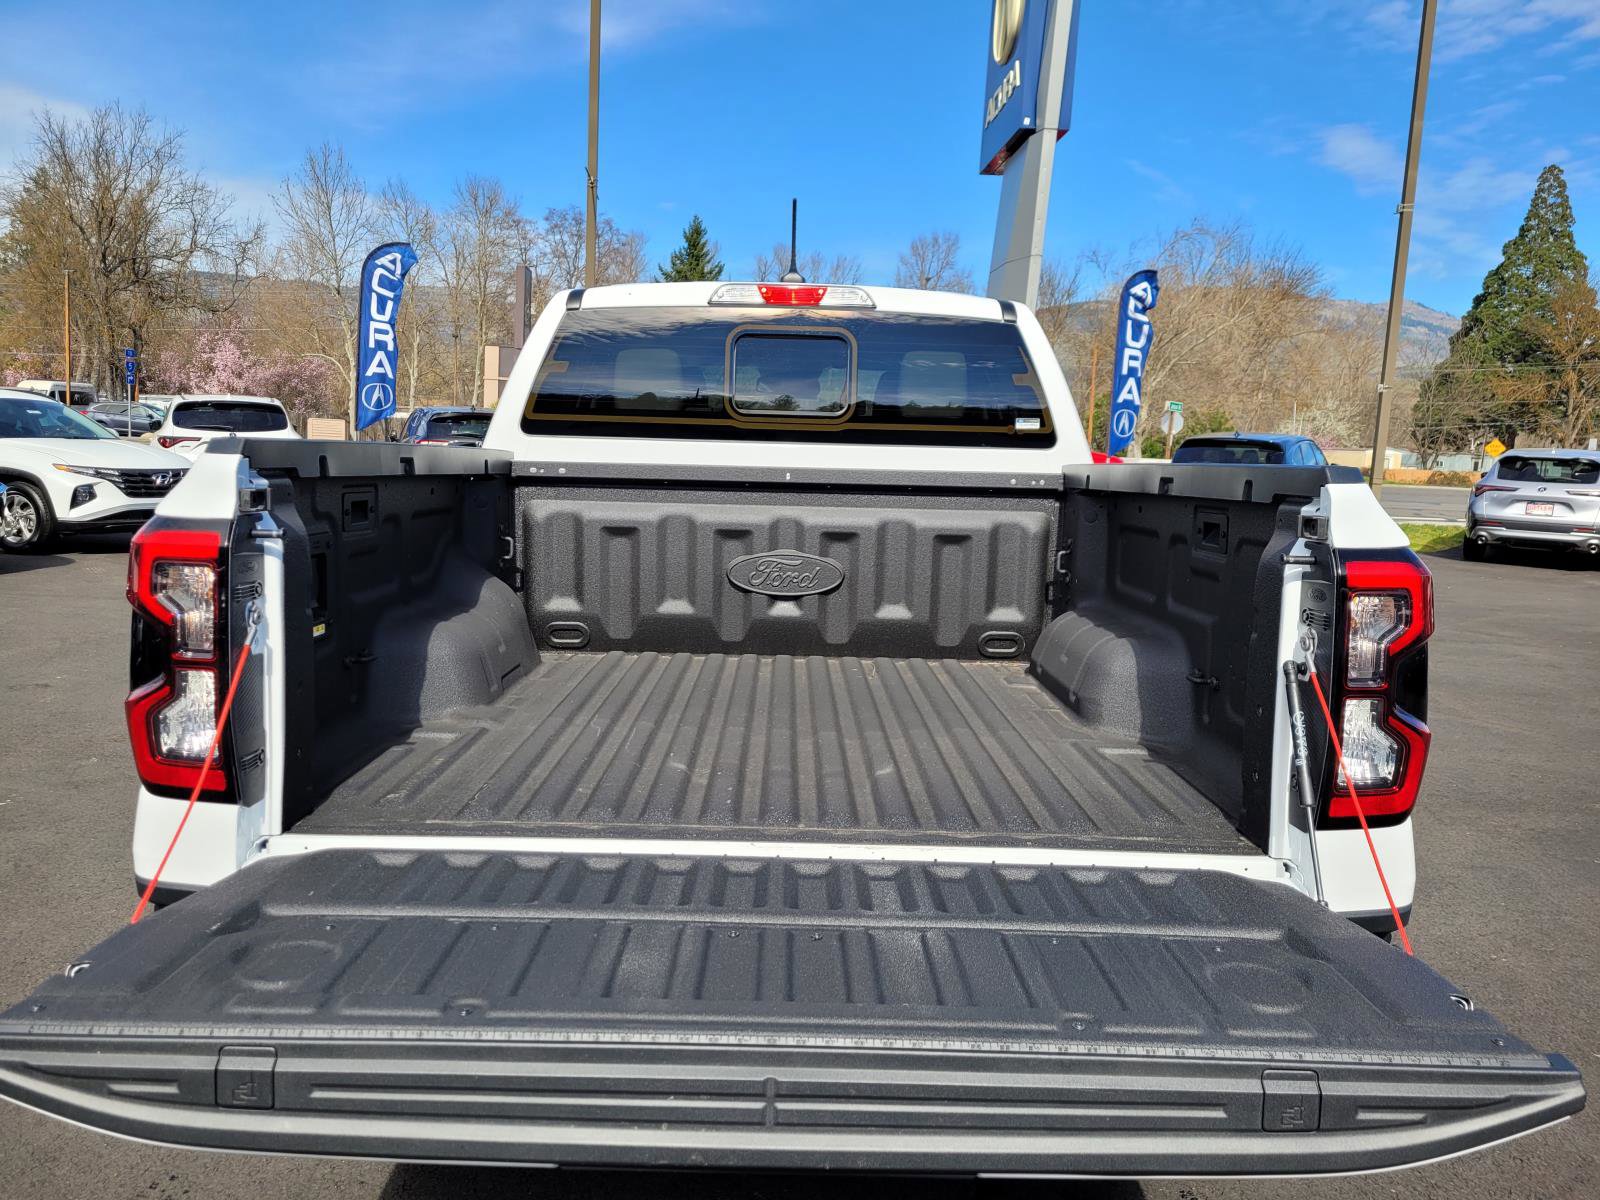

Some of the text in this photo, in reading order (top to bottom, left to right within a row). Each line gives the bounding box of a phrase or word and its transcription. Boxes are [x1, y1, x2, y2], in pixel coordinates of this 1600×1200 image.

[364, 252, 402, 380] ACURA
[1116, 280, 1153, 406] ACURA
[750, 557, 822, 588] Ford
